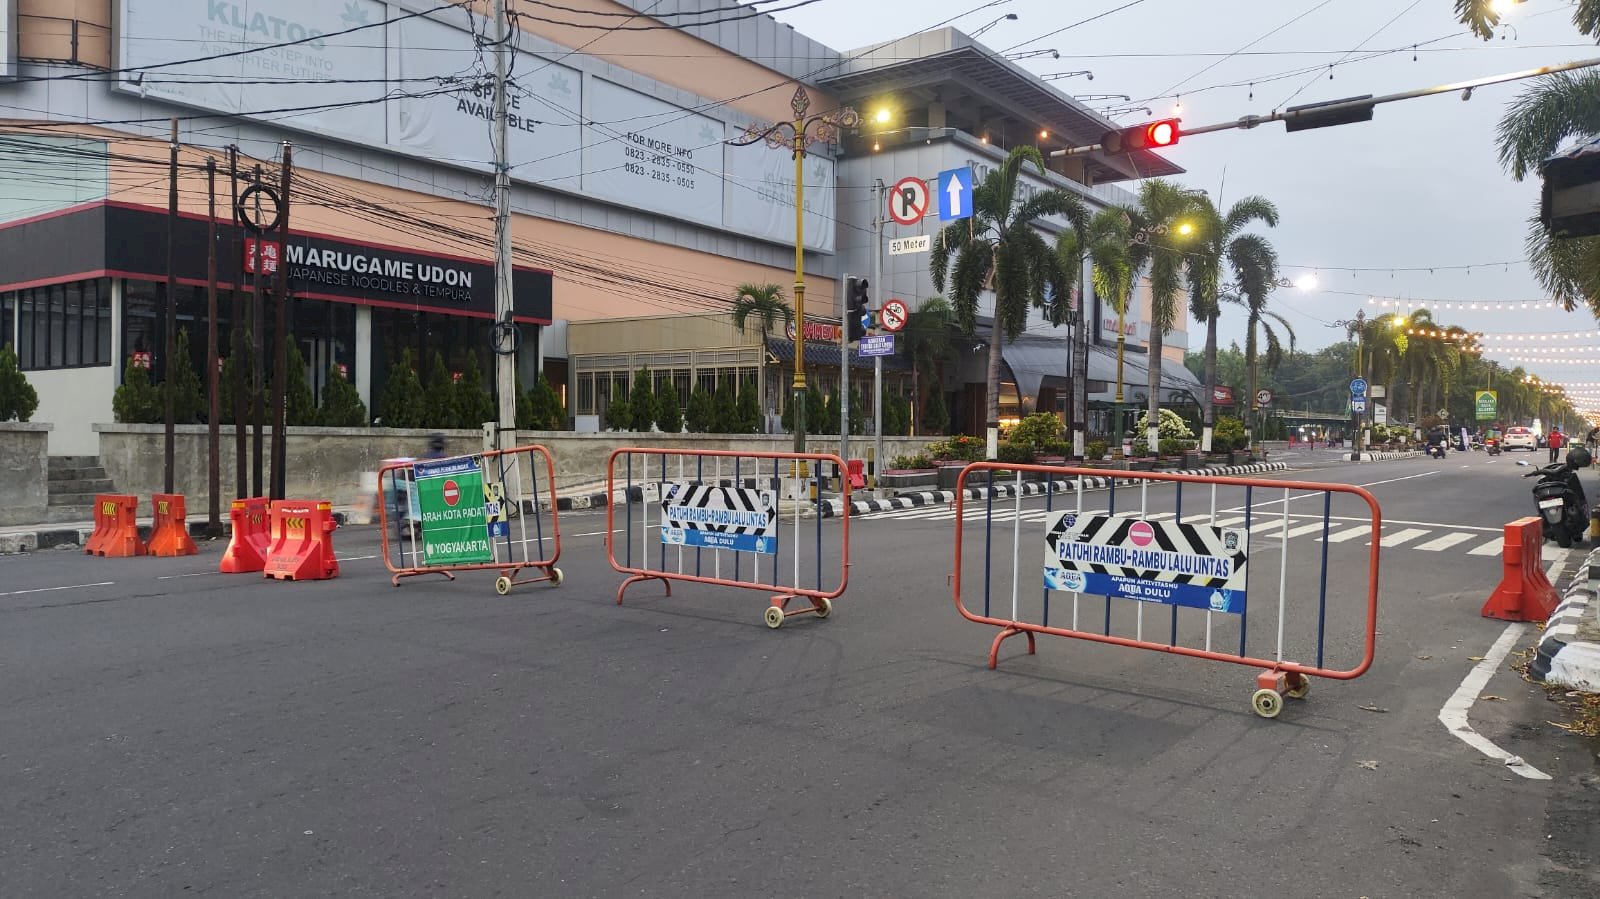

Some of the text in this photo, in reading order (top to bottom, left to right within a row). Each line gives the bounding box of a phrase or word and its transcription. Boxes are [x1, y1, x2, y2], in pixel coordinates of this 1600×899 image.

[207, 0, 325, 51] KLATOS
[197, 24, 226, 39] THE
[270, 48, 303, 60] STEP
[305, 55, 334, 71] INTO
[474, 85, 520, 109] SPE
[457, 98, 535, 133] AVAILBLE
[627, 132, 693, 160] FOR MORE INFO
[892, 239, 927, 252] 50 Meter
[286, 244, 472, 288] MARUGAME UDON
[287, 266, 472, 302] JAPANESE NOODLES & TEMPURA
[423, 506, 486, 523] ARAH KOTA PADAT
[486, 503, 499, 515] NTAS
[669, 506, 766, 527] PATUHI RAMBU-RAMBU LALU LINTAS
[434, 540, 489, 553] YOGYAKARTA
[1059, 541, 1229, 577] PATUHI RAMBU-RAMBU LALU LINTAS
[1111, 576, 1178, 589] APAPUN AKTIVITASMU
[1118, 583, 1171, 598] AQUA DULU
